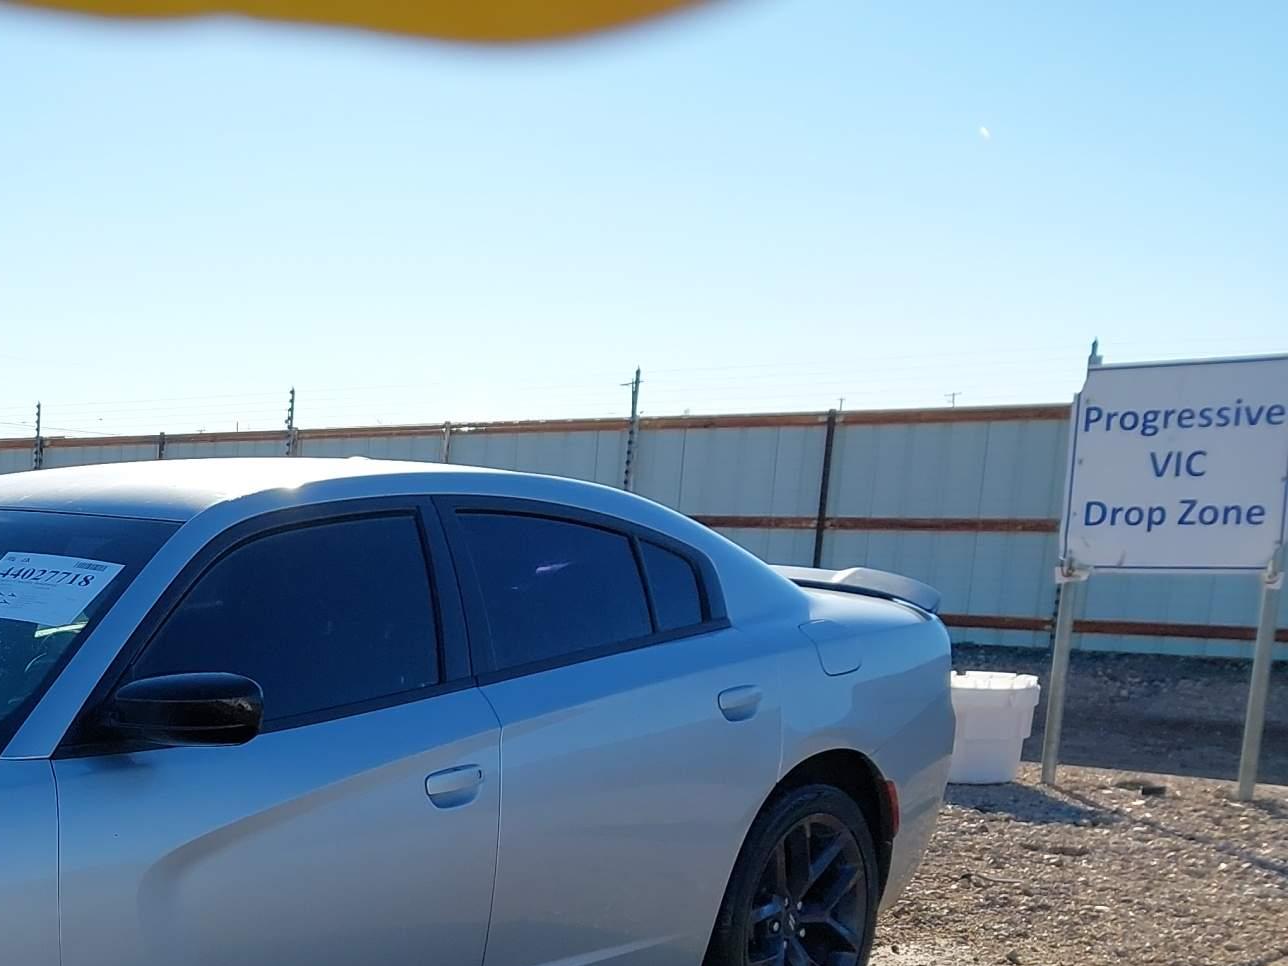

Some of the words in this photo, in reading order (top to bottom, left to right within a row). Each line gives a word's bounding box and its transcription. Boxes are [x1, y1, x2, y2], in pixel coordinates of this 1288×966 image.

[1083, 399, 1286, 437] Progressive
[1149, 449, 1208, 478] VIC
[1083, 500, 1167, 533] Drop
[1177, 499, 1267, 526] Zone
